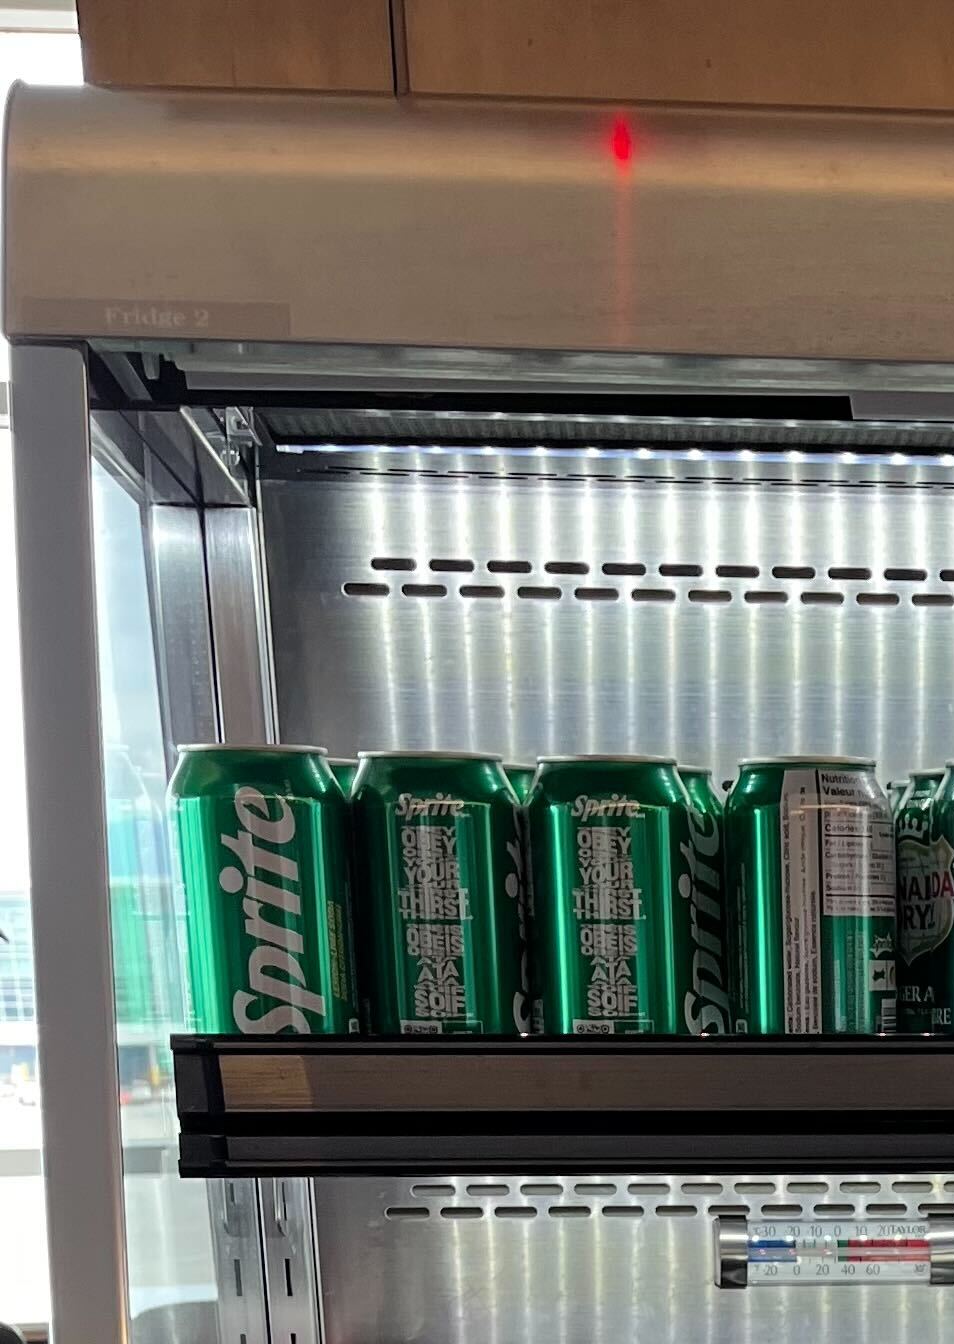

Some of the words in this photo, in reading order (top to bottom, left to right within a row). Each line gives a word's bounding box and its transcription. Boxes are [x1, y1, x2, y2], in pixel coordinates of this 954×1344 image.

[194, 307, 209, 327] 2
[395, 793, 465, 821] Sprite
[571, 794, 641, 822] Sprite
[219, 785, 326, 1033] Sprite
[833, 1226, 842, 1237] 0
[855, 1226, 867, 1237] 10
[878, 1226, 891, 1237] 20
[793, 1266, 800, 1276] 0
[816, 1265, 830, 1276] 20
[841, 1265, 856, 1276] 40
[865, 1265, 880, 1276] 60
